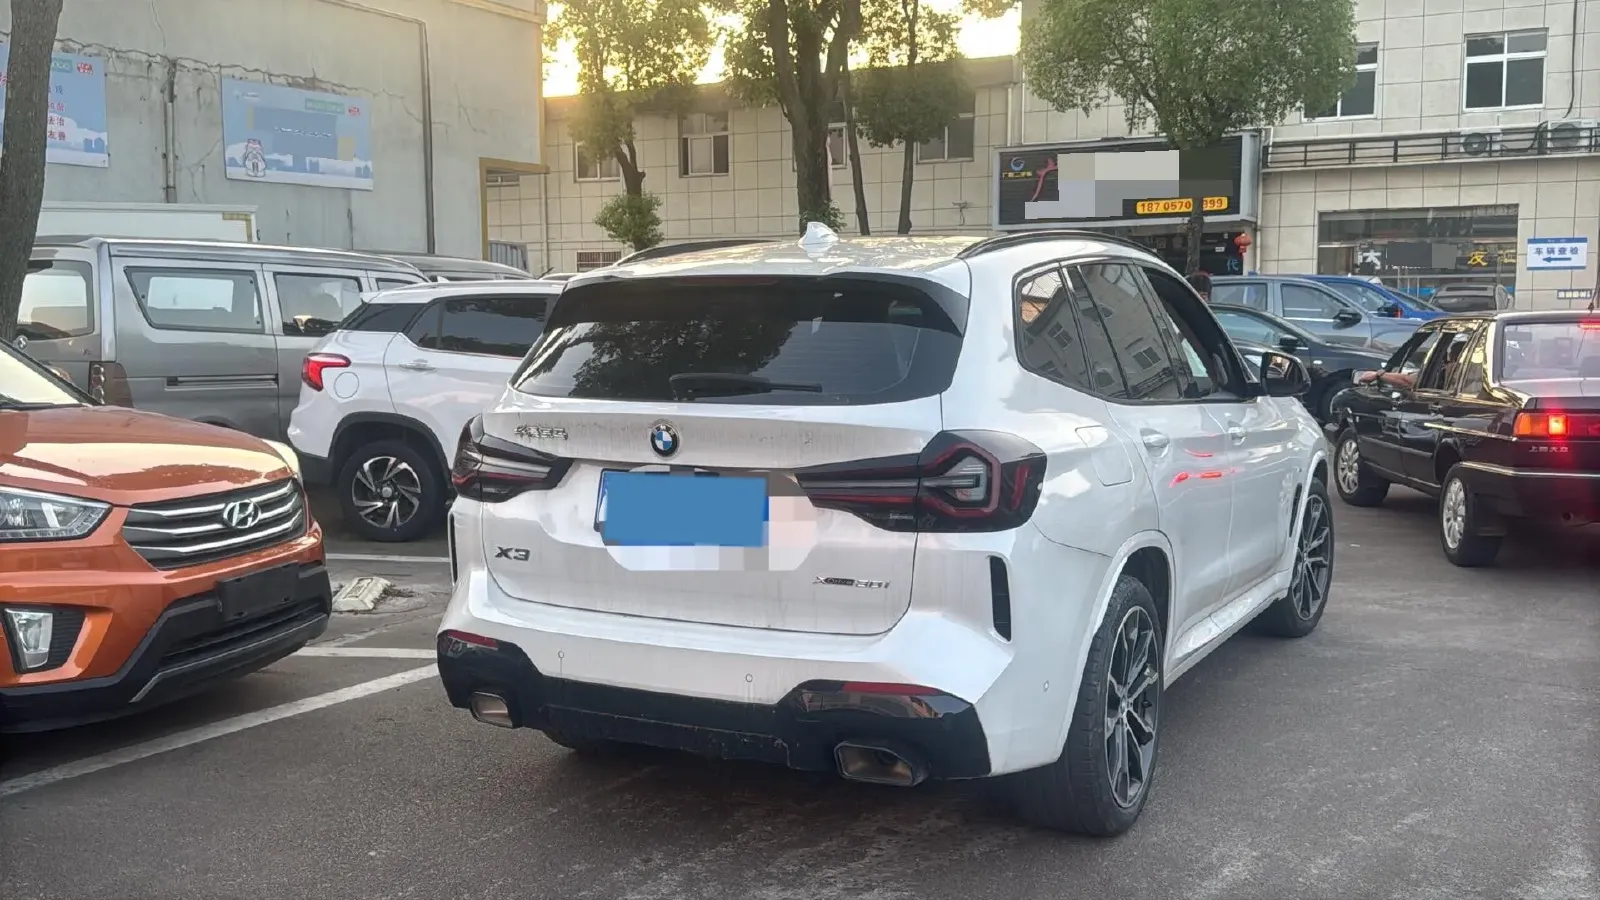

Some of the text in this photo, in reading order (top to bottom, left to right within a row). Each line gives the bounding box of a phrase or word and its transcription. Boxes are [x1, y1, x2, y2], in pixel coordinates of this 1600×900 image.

[1140, 198, 1223, 213] 187 0570 999
[1533, 246, 1579, 256] 车辆查验
[494, 546, 531, 562] X3
